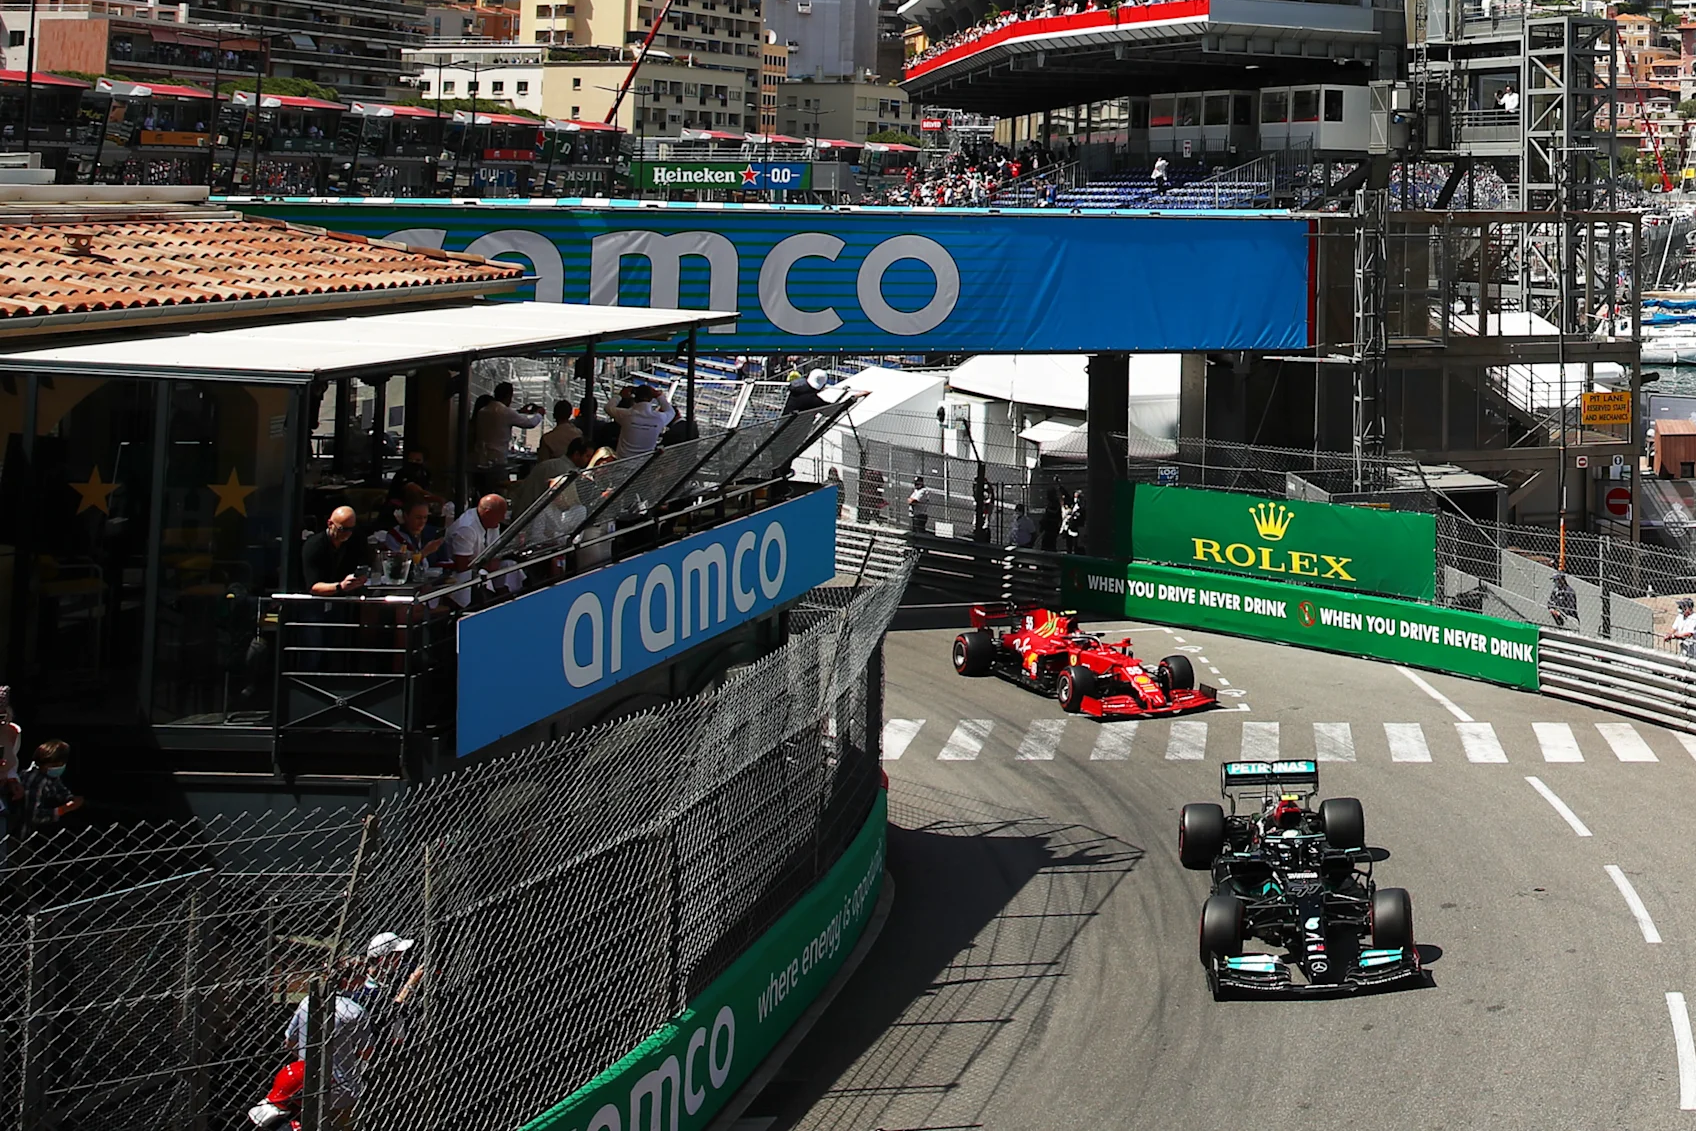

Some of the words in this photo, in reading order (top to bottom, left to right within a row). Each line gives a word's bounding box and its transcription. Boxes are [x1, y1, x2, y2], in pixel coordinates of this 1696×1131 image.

[653, 167, 736, 185] Heineken
[388, 228, 960, 336] amco
[1191, 538, 1356, 581] ROLEX
[562, 521, 787, 688] aramco
[1087, 574, 1125, 594] WHEN
[1127, 579, 1155, 599] YOU
[1158, 584, 1196, 604] DRIVE
[1200, 590, 1241, 611] NEVER
[1244, 596, 1287, 618] DRINK
[1025, 615, 1034, 630] 55
[1320, 607, 1362, 631] WHEN
[1366, 615, 1395, 636] YOU
[1400, 621, 1439, 644] DRIVE
[1444, 628, 1487, 652] NEVER
[1490, 636, 1534, 662] DRINK
[1126, 665, 1143, 675] 55
[757, 958, 799, 1023] where
[802, 910, 842, 975] energy
[843, 895, 851, 929] is
